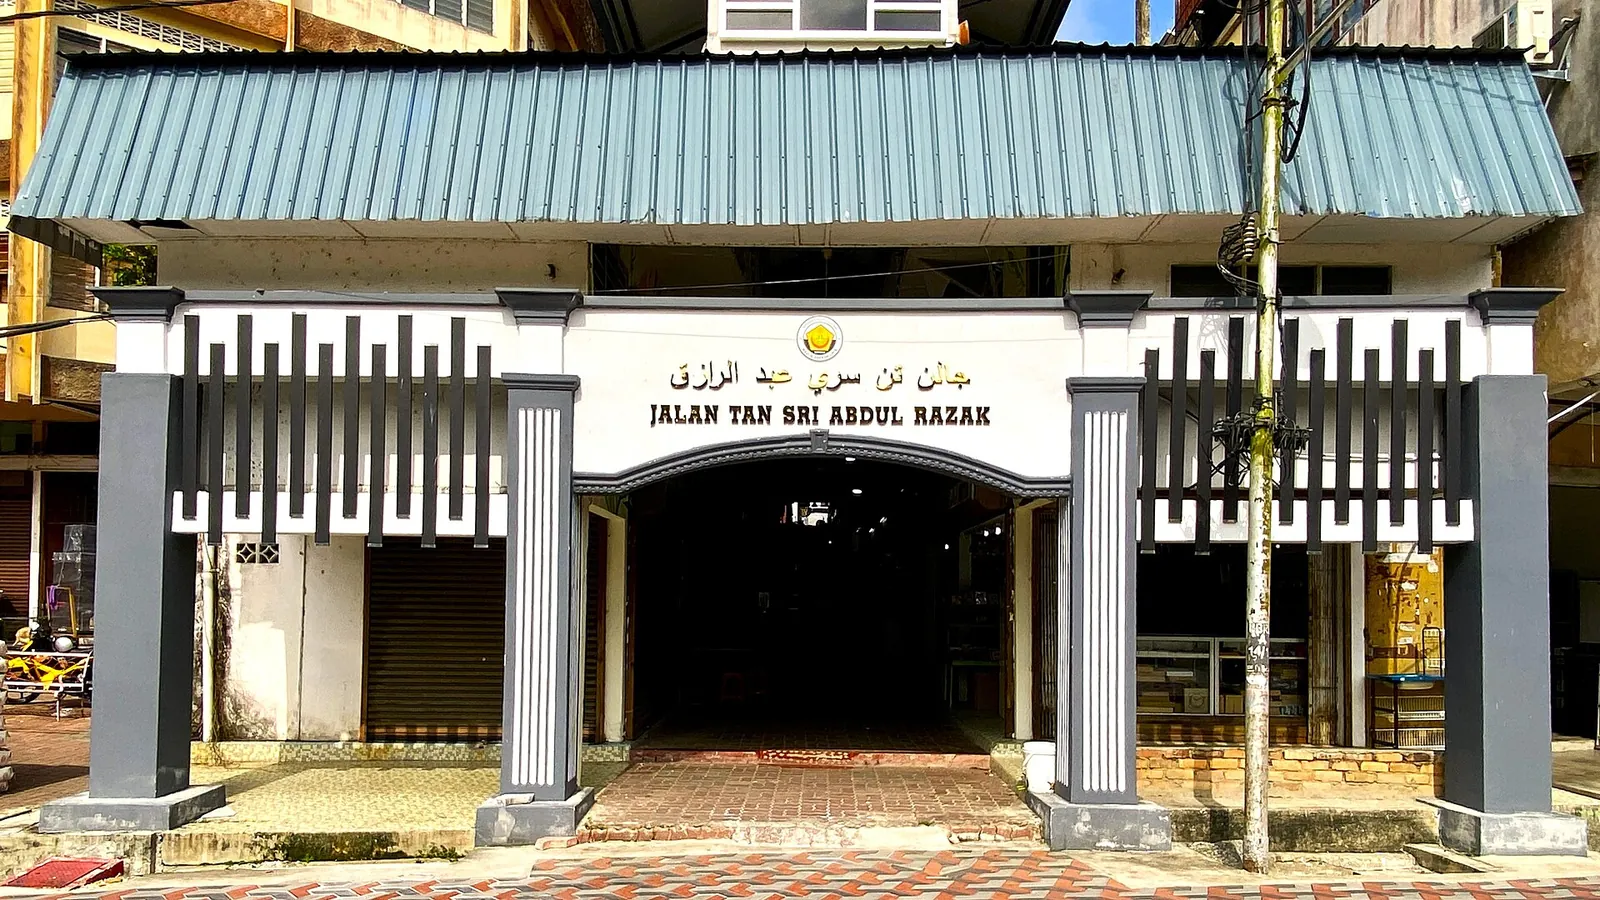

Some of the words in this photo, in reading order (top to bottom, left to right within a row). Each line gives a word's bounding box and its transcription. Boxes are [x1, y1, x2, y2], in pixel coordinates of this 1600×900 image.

[671, 360, 738, 390] الرازق
[756, 367, 793, 390] عبد
[808, 371, 861, 396] سري
[876, 365, 903, 391] تن
[918, 361, 971, 391] جالن
[651, 404, 718, 427] JALAN
[729, 405, 772, 425] TAN
[783, 405, 819, 425] SRI
[829, 405, 904, 426] ABDUL
[914, 405, 990, 425] RAZAK
